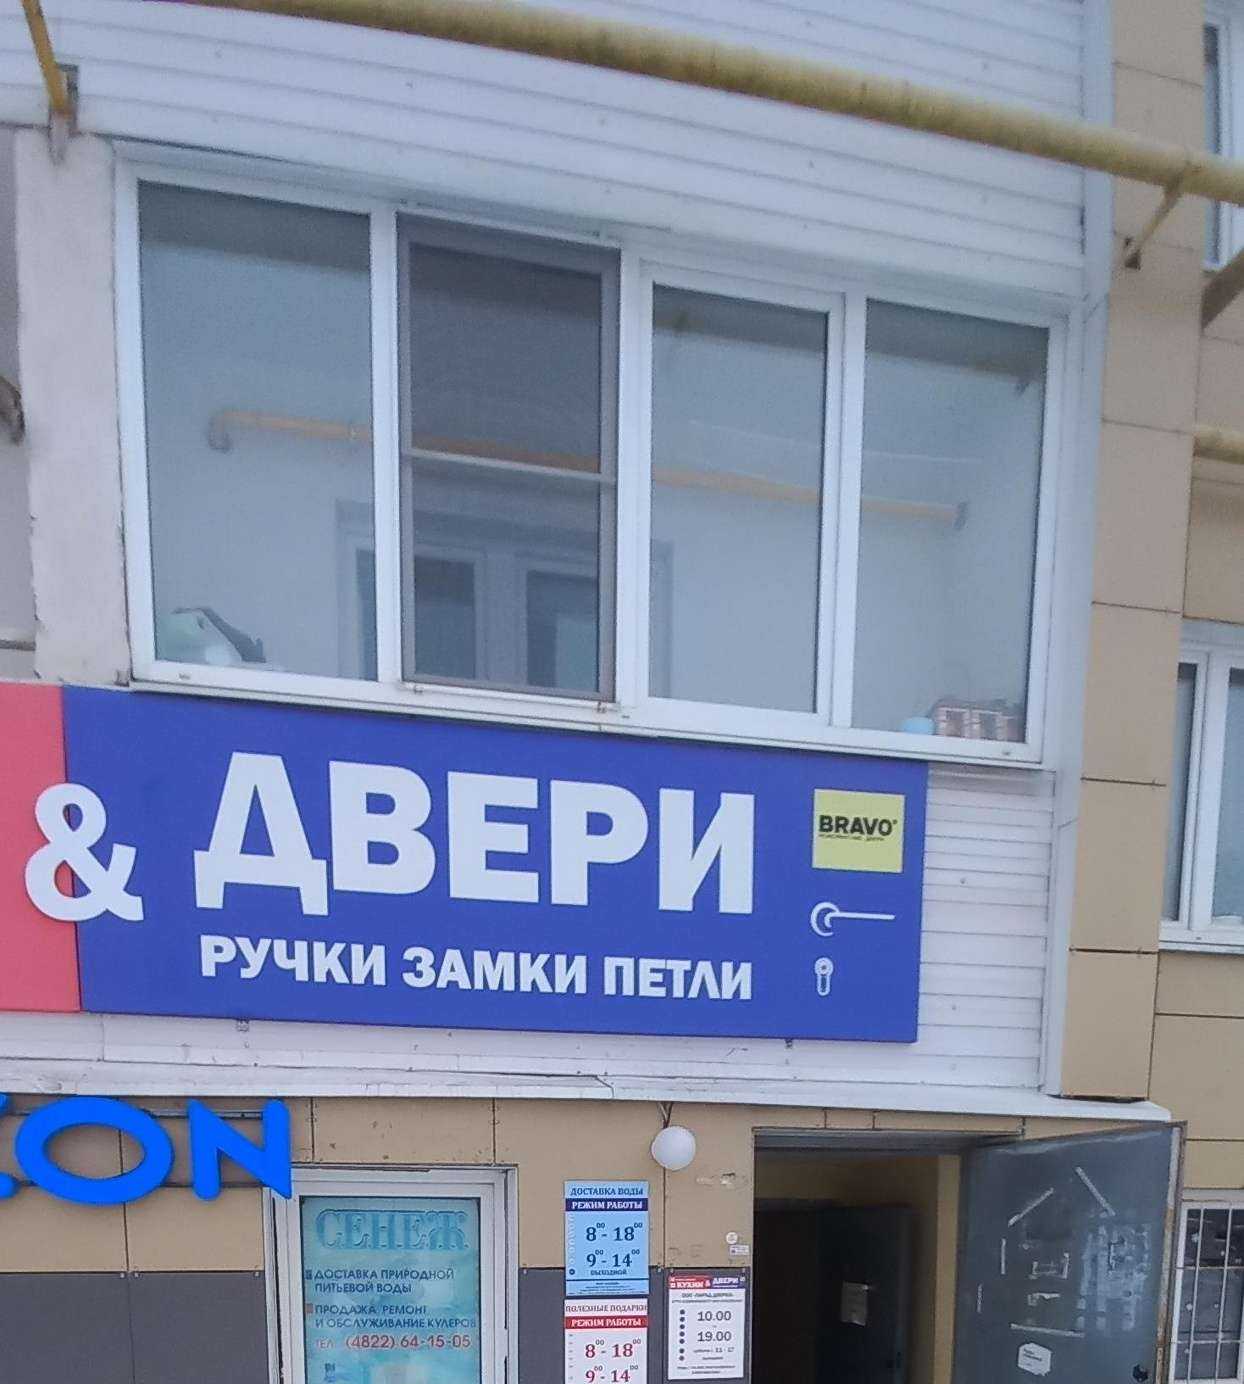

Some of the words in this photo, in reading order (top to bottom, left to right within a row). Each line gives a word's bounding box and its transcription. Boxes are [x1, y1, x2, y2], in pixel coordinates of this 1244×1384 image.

[25, 783, 144, 921] &
[194, 752, 756, 916] ДВЕРИ
[200, 934, 387, 986] РУЧКИ
[401, 946, 588, 994] ЗАМКИ
[602, 956, 753, 1001] ПЕТЛИ
[0, 1091, 292, 1207] ON
[570, 1187, 616, 1196] ДОСТАВКА
[618, 1187, 644, 1196] ВОДЫ
[571, 1200, 605, 1210] РЕЖИМ
[606, 1200, 643, 1210] РАБОТЫ
[315, 1208, 469, 1250] СЕНЕЖ
[314, 1269, 378, 1280] ДОСТАВКА
[380, 1268, 454, 1281] ПРИРОДНОЙ
[315, 1281, 374, 1293] ПИТЬЕВОЙ
[376, 1283, 412, 1294] ВОДЫ
[697, 1310, 732, 1322] 10.00
[315, 1318, 324, 1328] И
[326, 1318, 425, 1329] ОБСЛУЖИВАНИЕ
[427, 1318, 477, 1329] КУЛЕРОВ
[571, 1319, 604, 1328] РЕЖИМ
[606, 1318, 642, 1327] РАБОТЫ
[345, 1333, 396, 1349] (4822)
[400, 1333, 472, 1348] 64-15-05
[697, 1331, 732, 1342] 19.00
